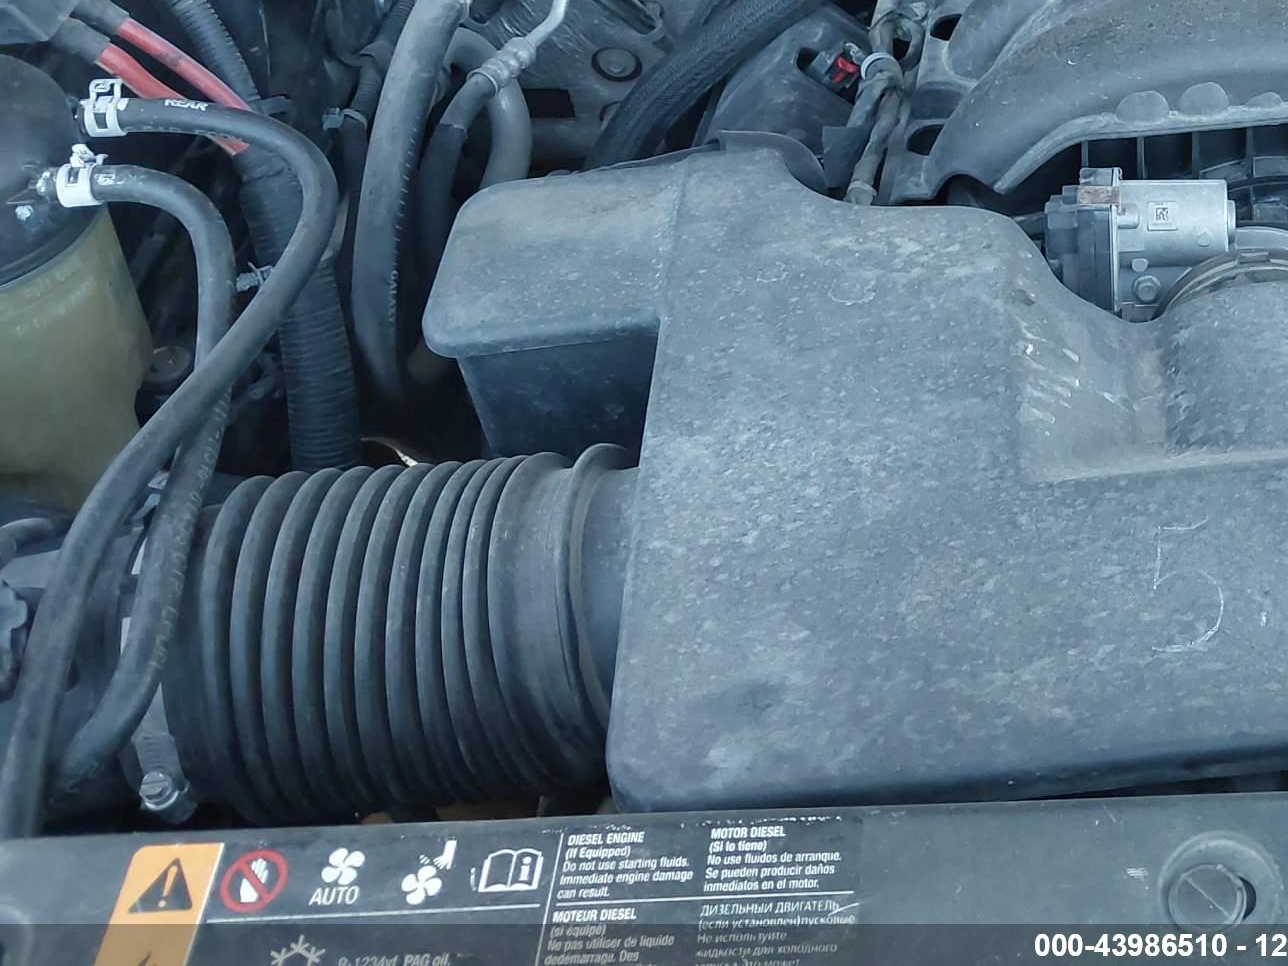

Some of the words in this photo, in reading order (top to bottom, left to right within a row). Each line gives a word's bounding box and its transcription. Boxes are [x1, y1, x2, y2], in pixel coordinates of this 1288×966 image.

[567, 833, 604, 846] DIESEL
[606, 831, 645, 844] ENGINE
[710, 826, 748, 839] MOTOR
[749, 825, 787, 838] DIESEL
[565, 847, 578, 860] (If
[579, 845, 631, 860] Equipped)
[708, 840, 723, 854] (Si
[725, 841, 736, 852] lo
[738, 839, 767, 852] tiene)
[562, 861, 576, 872] Do
[578, 860, 596, 871] not
[597, 860, 616, 871] use
[618, 858, 657, 870] starting
[659, 855, 690, 868] fluids.
[707, 854, 722, 866] No
[723, 855, 742, 865] use
[744, 852, 778, 864] fluidos
[780, 851, 793, 862] de
[795, 851, 842, 863] arranque.
[560, 873, 614, 885] Immediate
[615, 872, 650, 885] engine
[652, 870, 694, 883] damage
[705, 867, 719, 879] Se
[720, 867, 759, 880] pueden
[760, 865, 803, 878] producir
[805, 863, 835, 875] daños
[557, 888, 577, 899] can
[578, 886, 610, 898] result.
[703, 880, 759, 892] inmediatos
[761, 880, 774, 890] en
[776, 878, 787, 889] el
[788, 878, 820, 889] motor.
[308, 886, 360, 907] AUTO
[775, 899, 841, 914] ДВИГАТЕЛЬ
[552, 910, 598, 923] MOTEUR
[600, 908, 637, 921] DIESEL
[549, 925, 563, 939] (si
[566, 923, 606, 938] équipé)
[547, 939, 562, 951] Ne
[564, 939, 584, 952] pas
[585, 936, 622, 949] utiliser
[623, 936, 638, 947] de
[639, 933, 675, 948] liquide
[403, 952, 431, 966] PAG
[619, 949, 640, 962] Des
